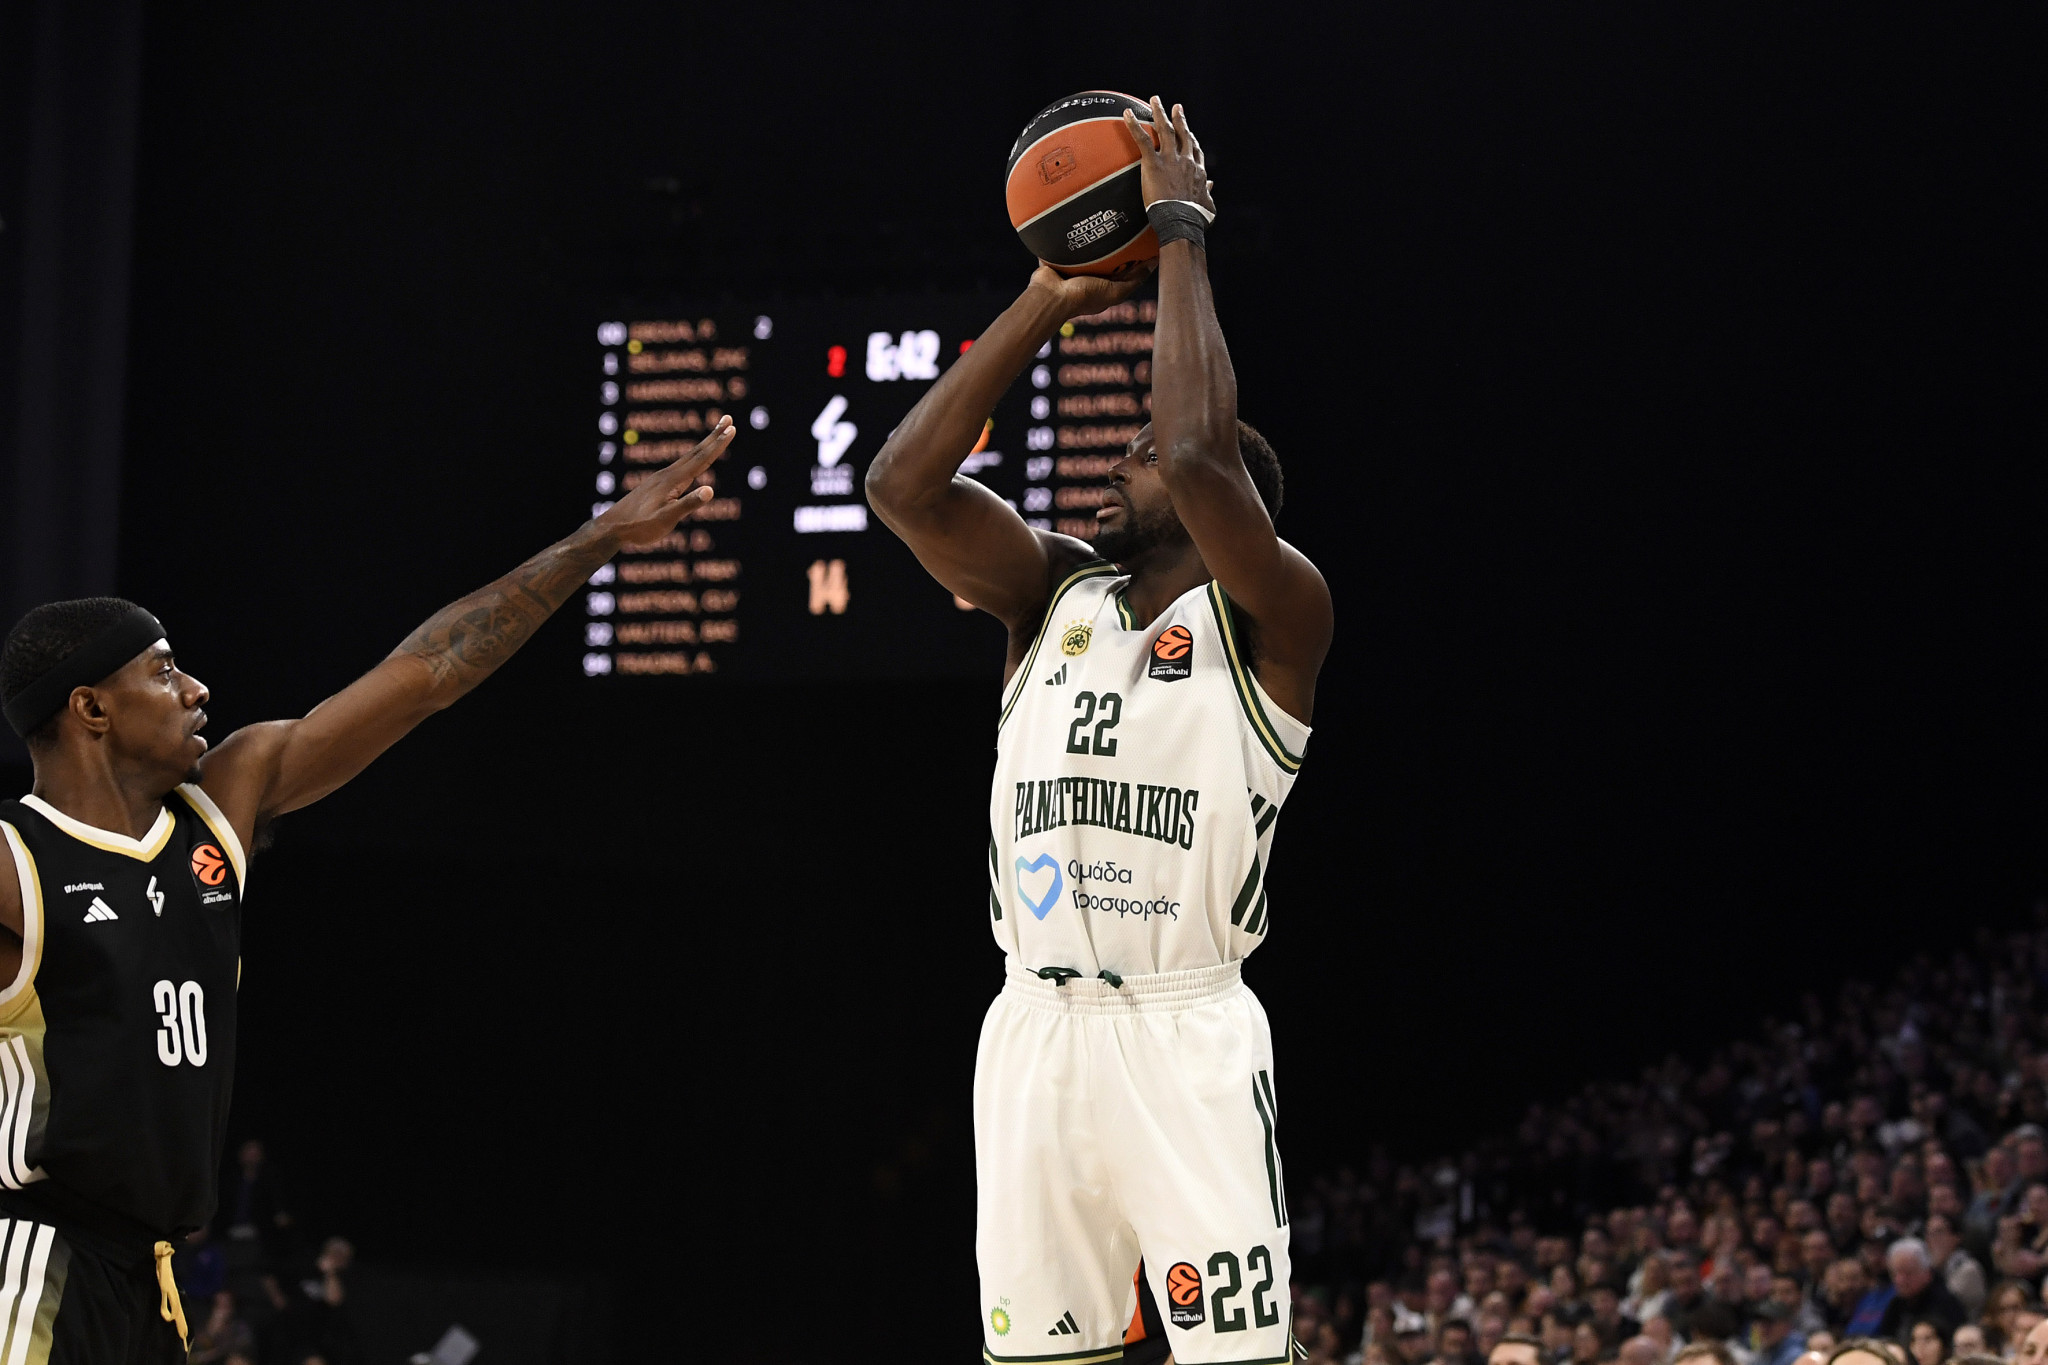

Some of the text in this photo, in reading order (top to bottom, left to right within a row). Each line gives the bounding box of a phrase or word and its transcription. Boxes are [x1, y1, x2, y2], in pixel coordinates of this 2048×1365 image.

[1068, 211, 1129, 252] LEGACY
[1150, 668, 1189, 677] abu dhabi
[1065, 690, 1123, 757] 22
[1014, 776, 1200, 851] PANATHINAIKOS
[1067, 859, 1132, 884] Ομάδα
[153, 979, 208, 1067] 30
[999, 1296, 1011, 1306] bp
[1206, 1244, 1280, 1333] 22
